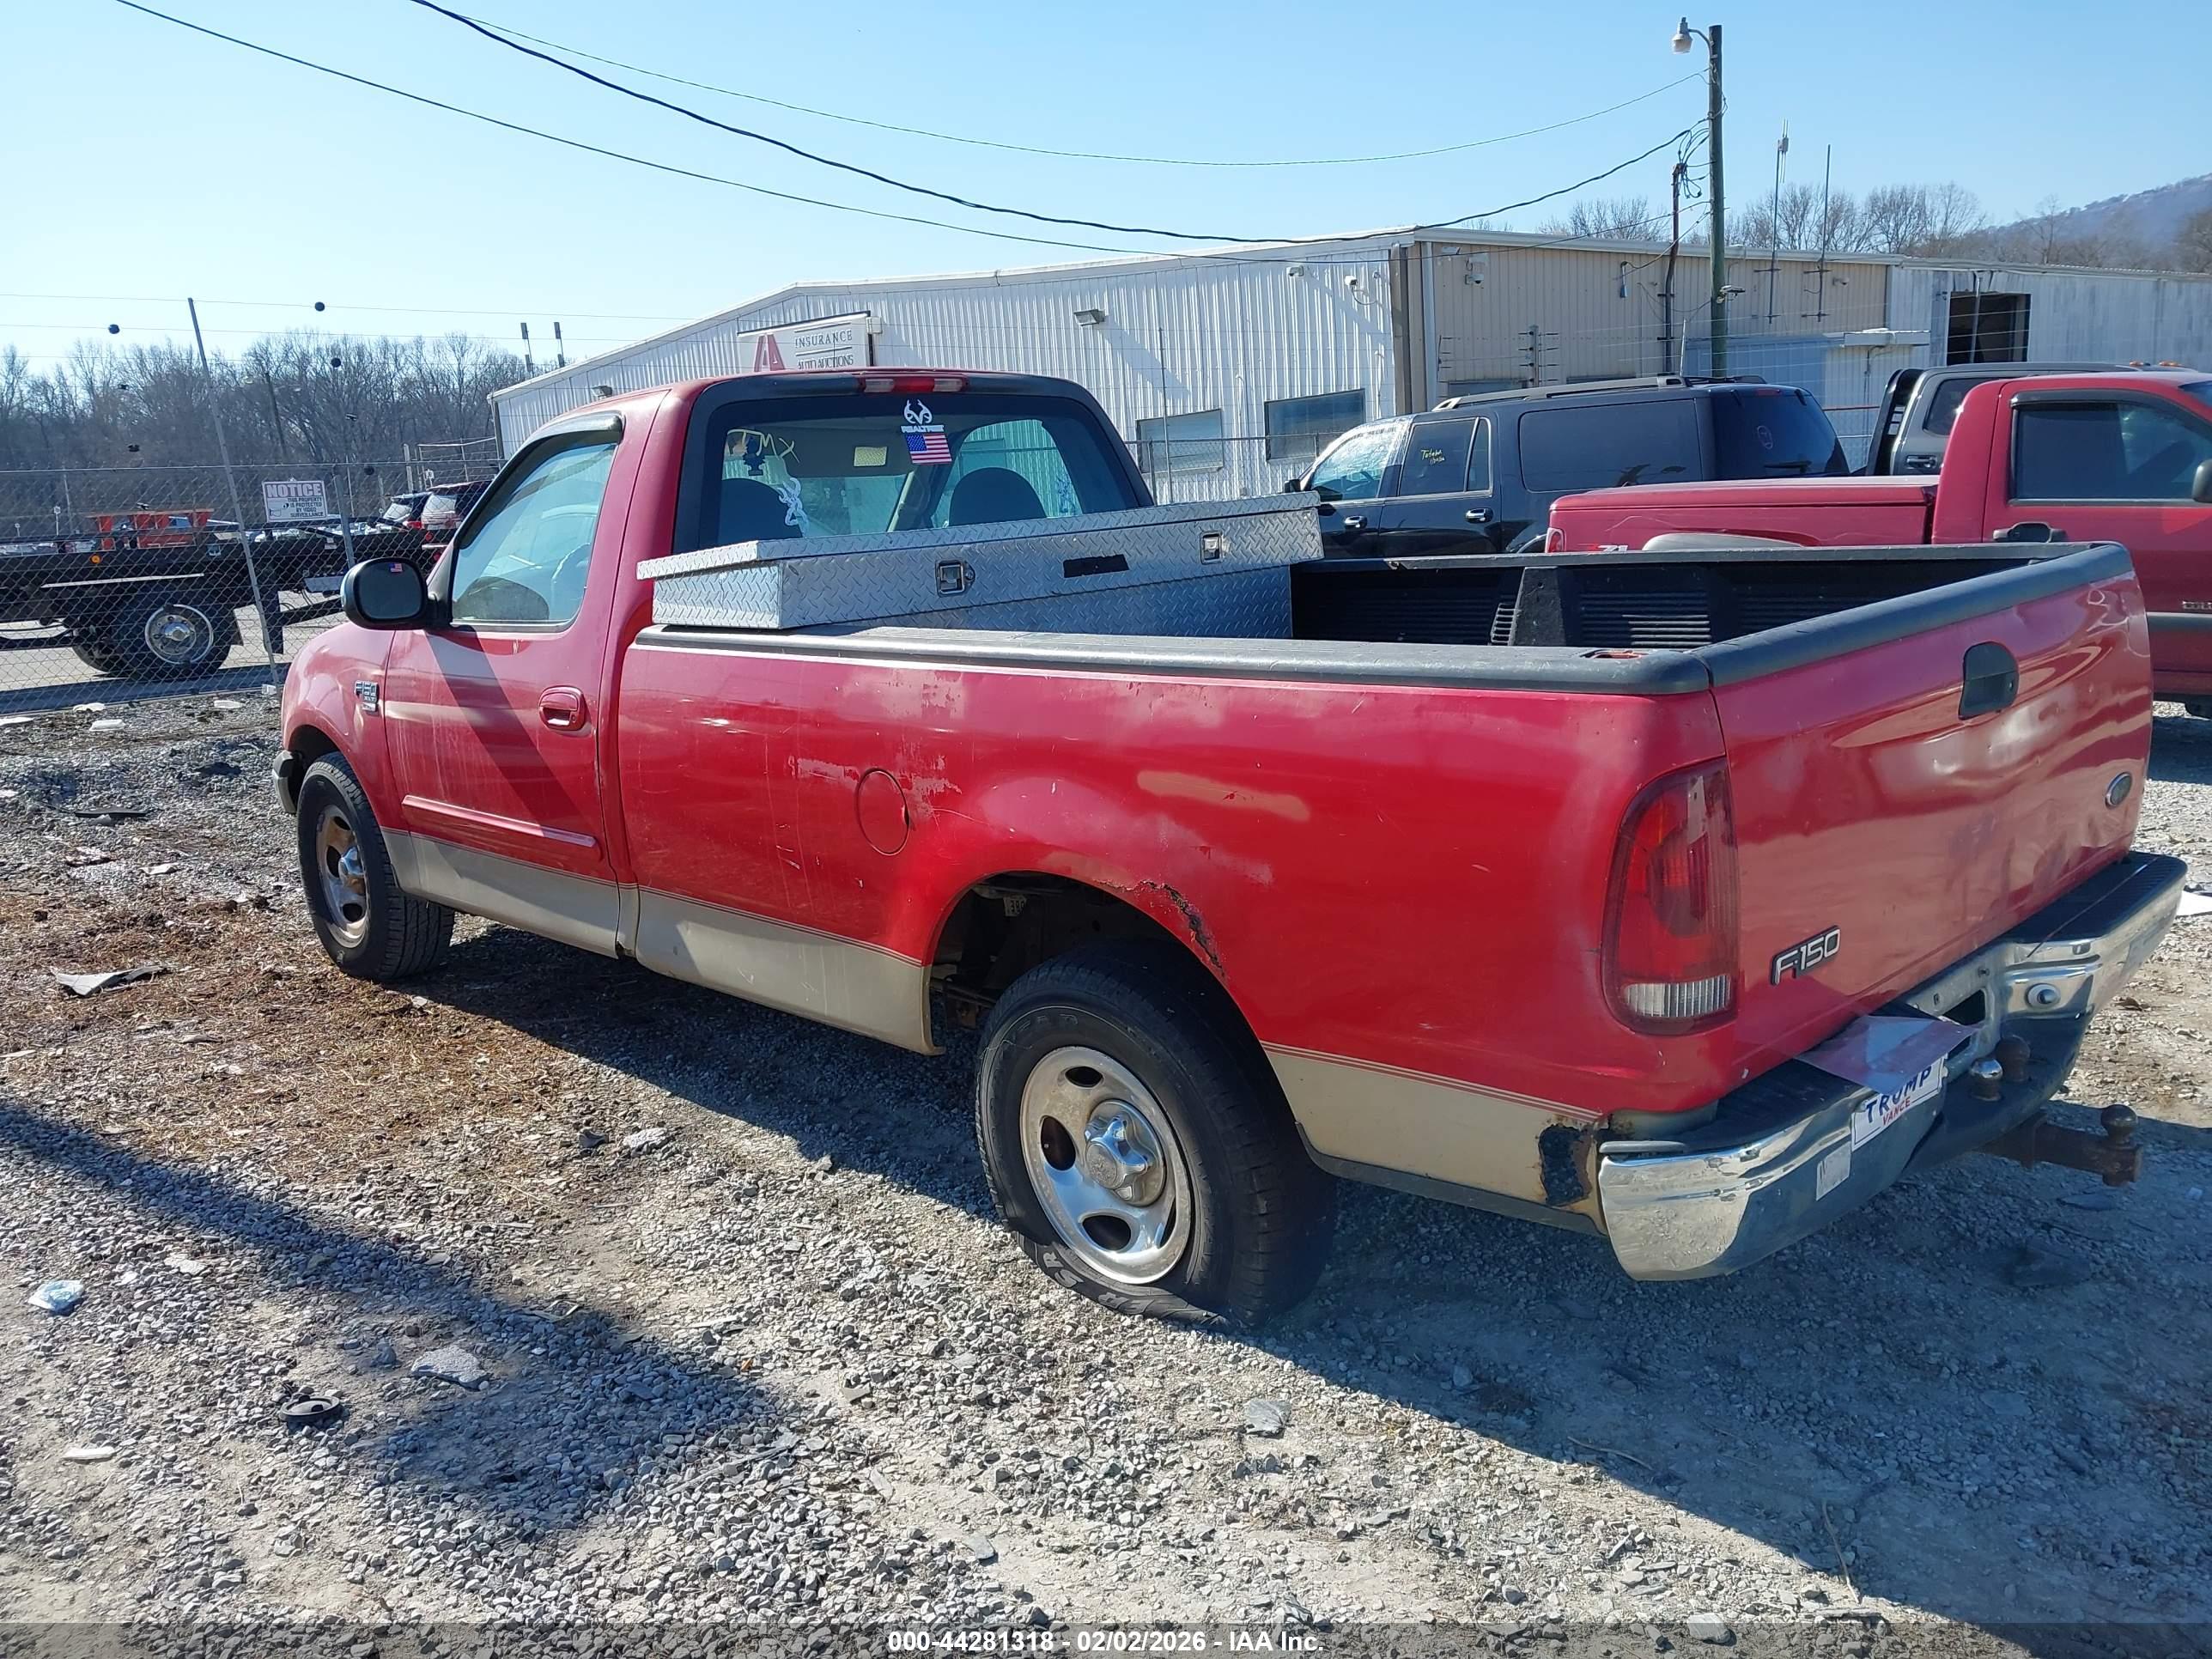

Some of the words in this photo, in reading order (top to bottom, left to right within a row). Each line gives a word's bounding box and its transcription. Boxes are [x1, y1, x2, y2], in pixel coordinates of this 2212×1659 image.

[795, 330, 852, 349] INSURANCE
[817, 354, 854, 368] AUCTIONS
[266, 483, 322, 497] NOTICE
[1865, 1065, 1932, 1124] TRUMP
[1882, 1096, 1911, 1127] VANCE
